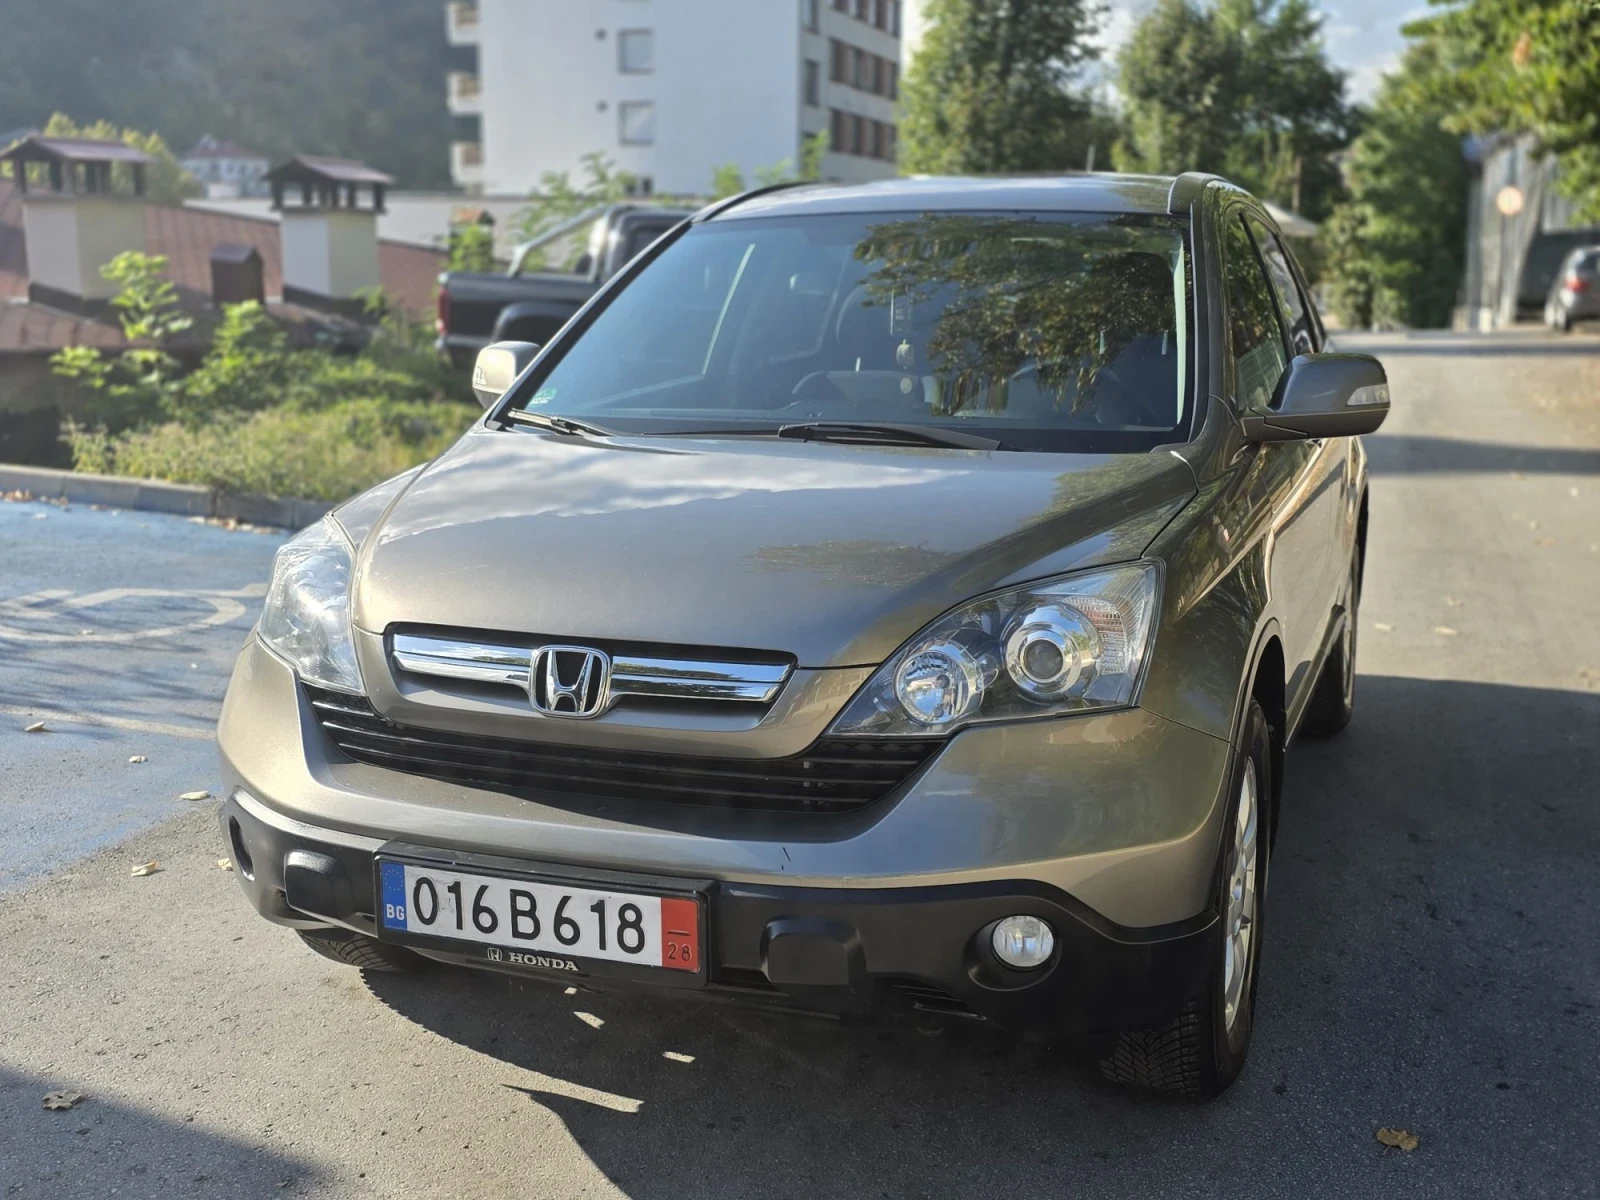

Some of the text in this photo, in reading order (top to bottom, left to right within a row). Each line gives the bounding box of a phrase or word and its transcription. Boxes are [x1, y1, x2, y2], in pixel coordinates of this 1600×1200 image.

[386, 903, 404, 921] BG
[412, 876, 646, 954] 016B618
[508, 952, 579, 971] HONDA
[667, 941, 692, 962] 28
